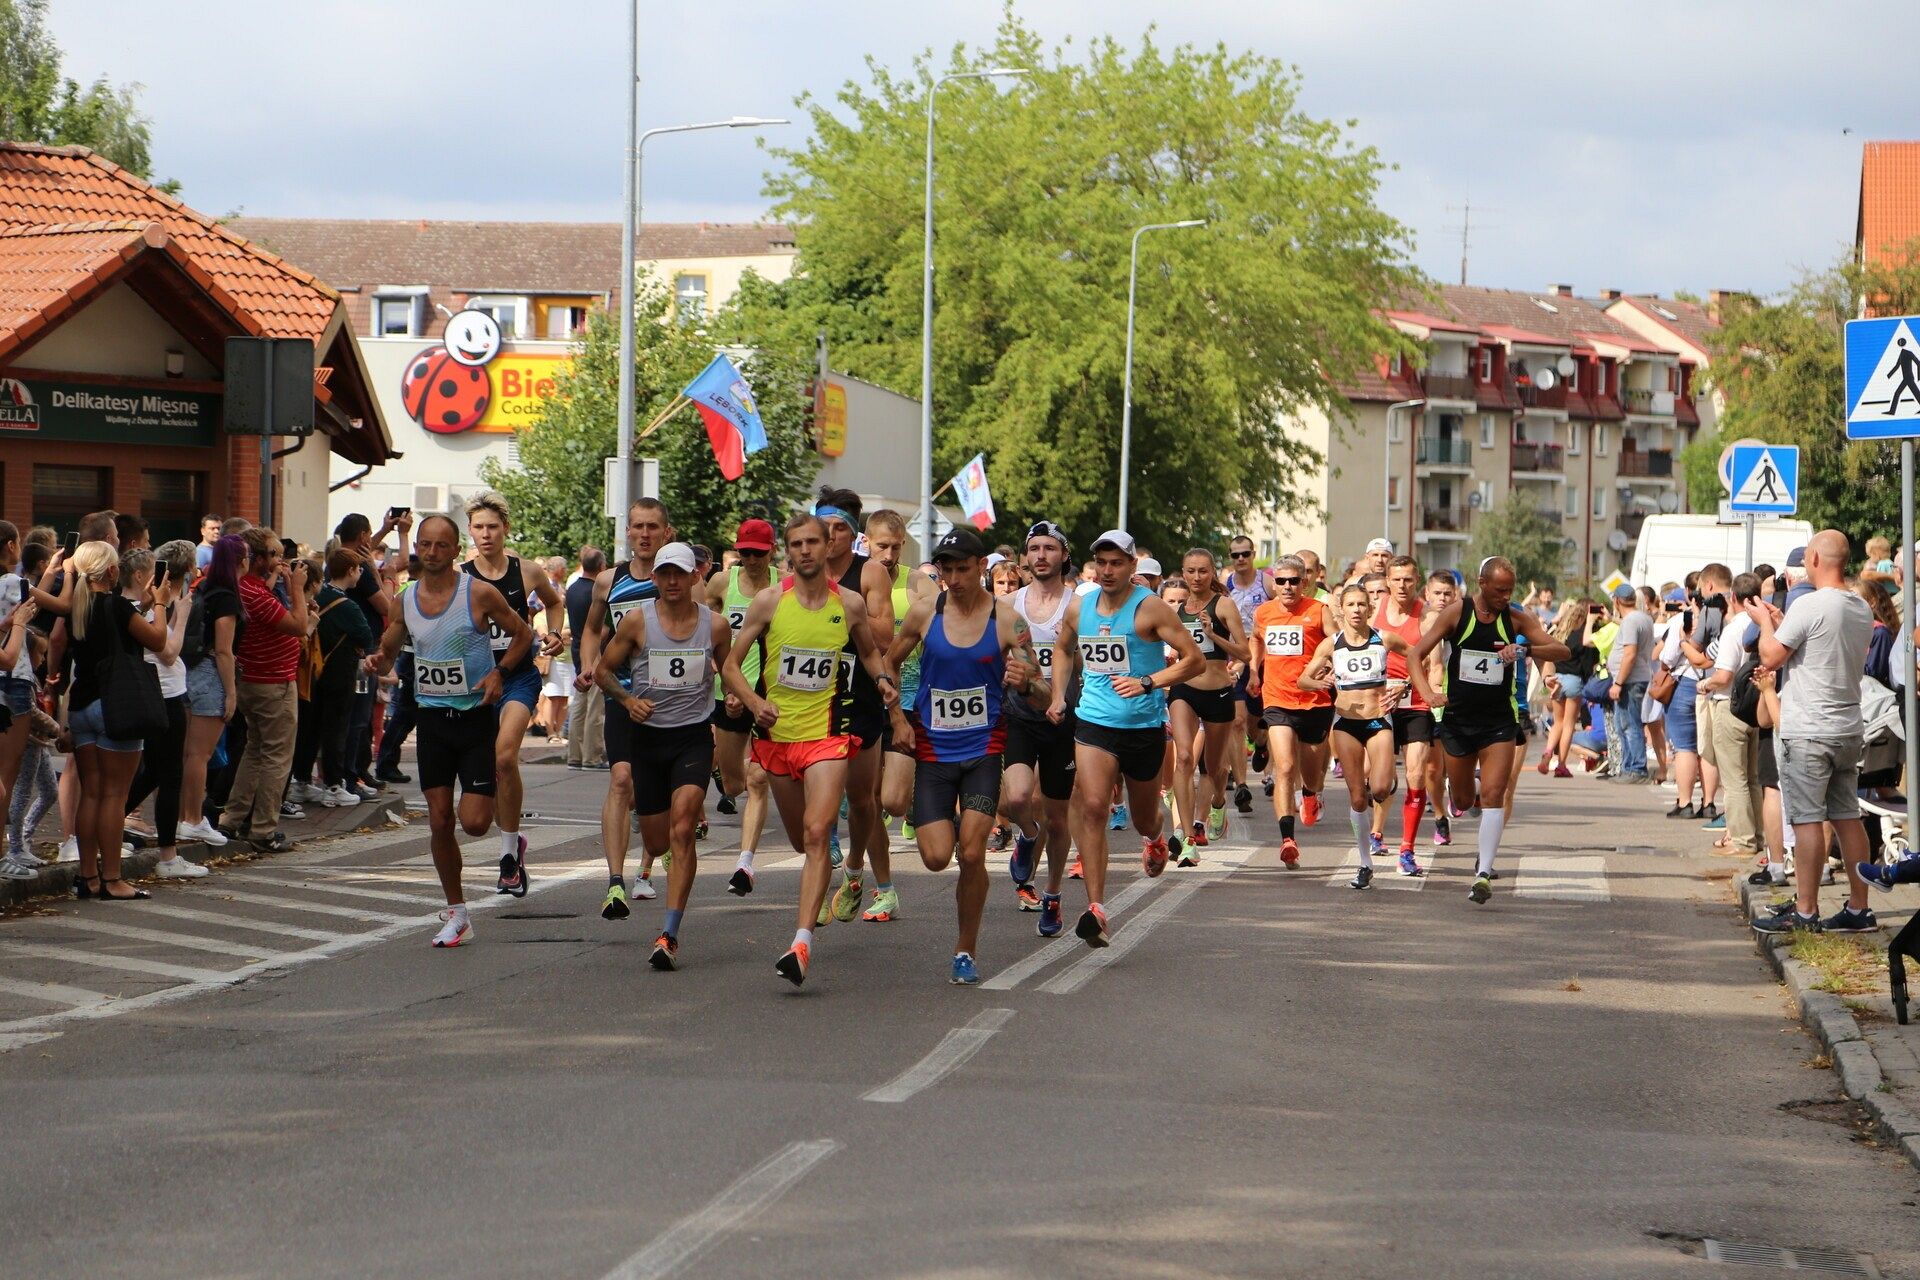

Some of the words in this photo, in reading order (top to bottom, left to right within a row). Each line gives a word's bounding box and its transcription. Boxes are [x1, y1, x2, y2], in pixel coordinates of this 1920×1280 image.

[501, 368, 557, 400] Bie
[52, 391, 139, 414] Delikatesy
[143, 395, 199, 417] Mięsne
[501, 400, 545, 415] Codz
[1192, 629, 1205, 644] 5
[1267, 631, 1301, 646] 258
[1037, 649, 1053, 670] 8
[1081, 643, 1126, 663] 250
[669, 657, 686, 678] 8
[782, 655, 833, 679] 146
[1347, 656, 1373, 673] 69
[1474, 658, 1489, 674] 4
[417, 665, 463, 686] 205
[934, 695, 984, 718] 196
